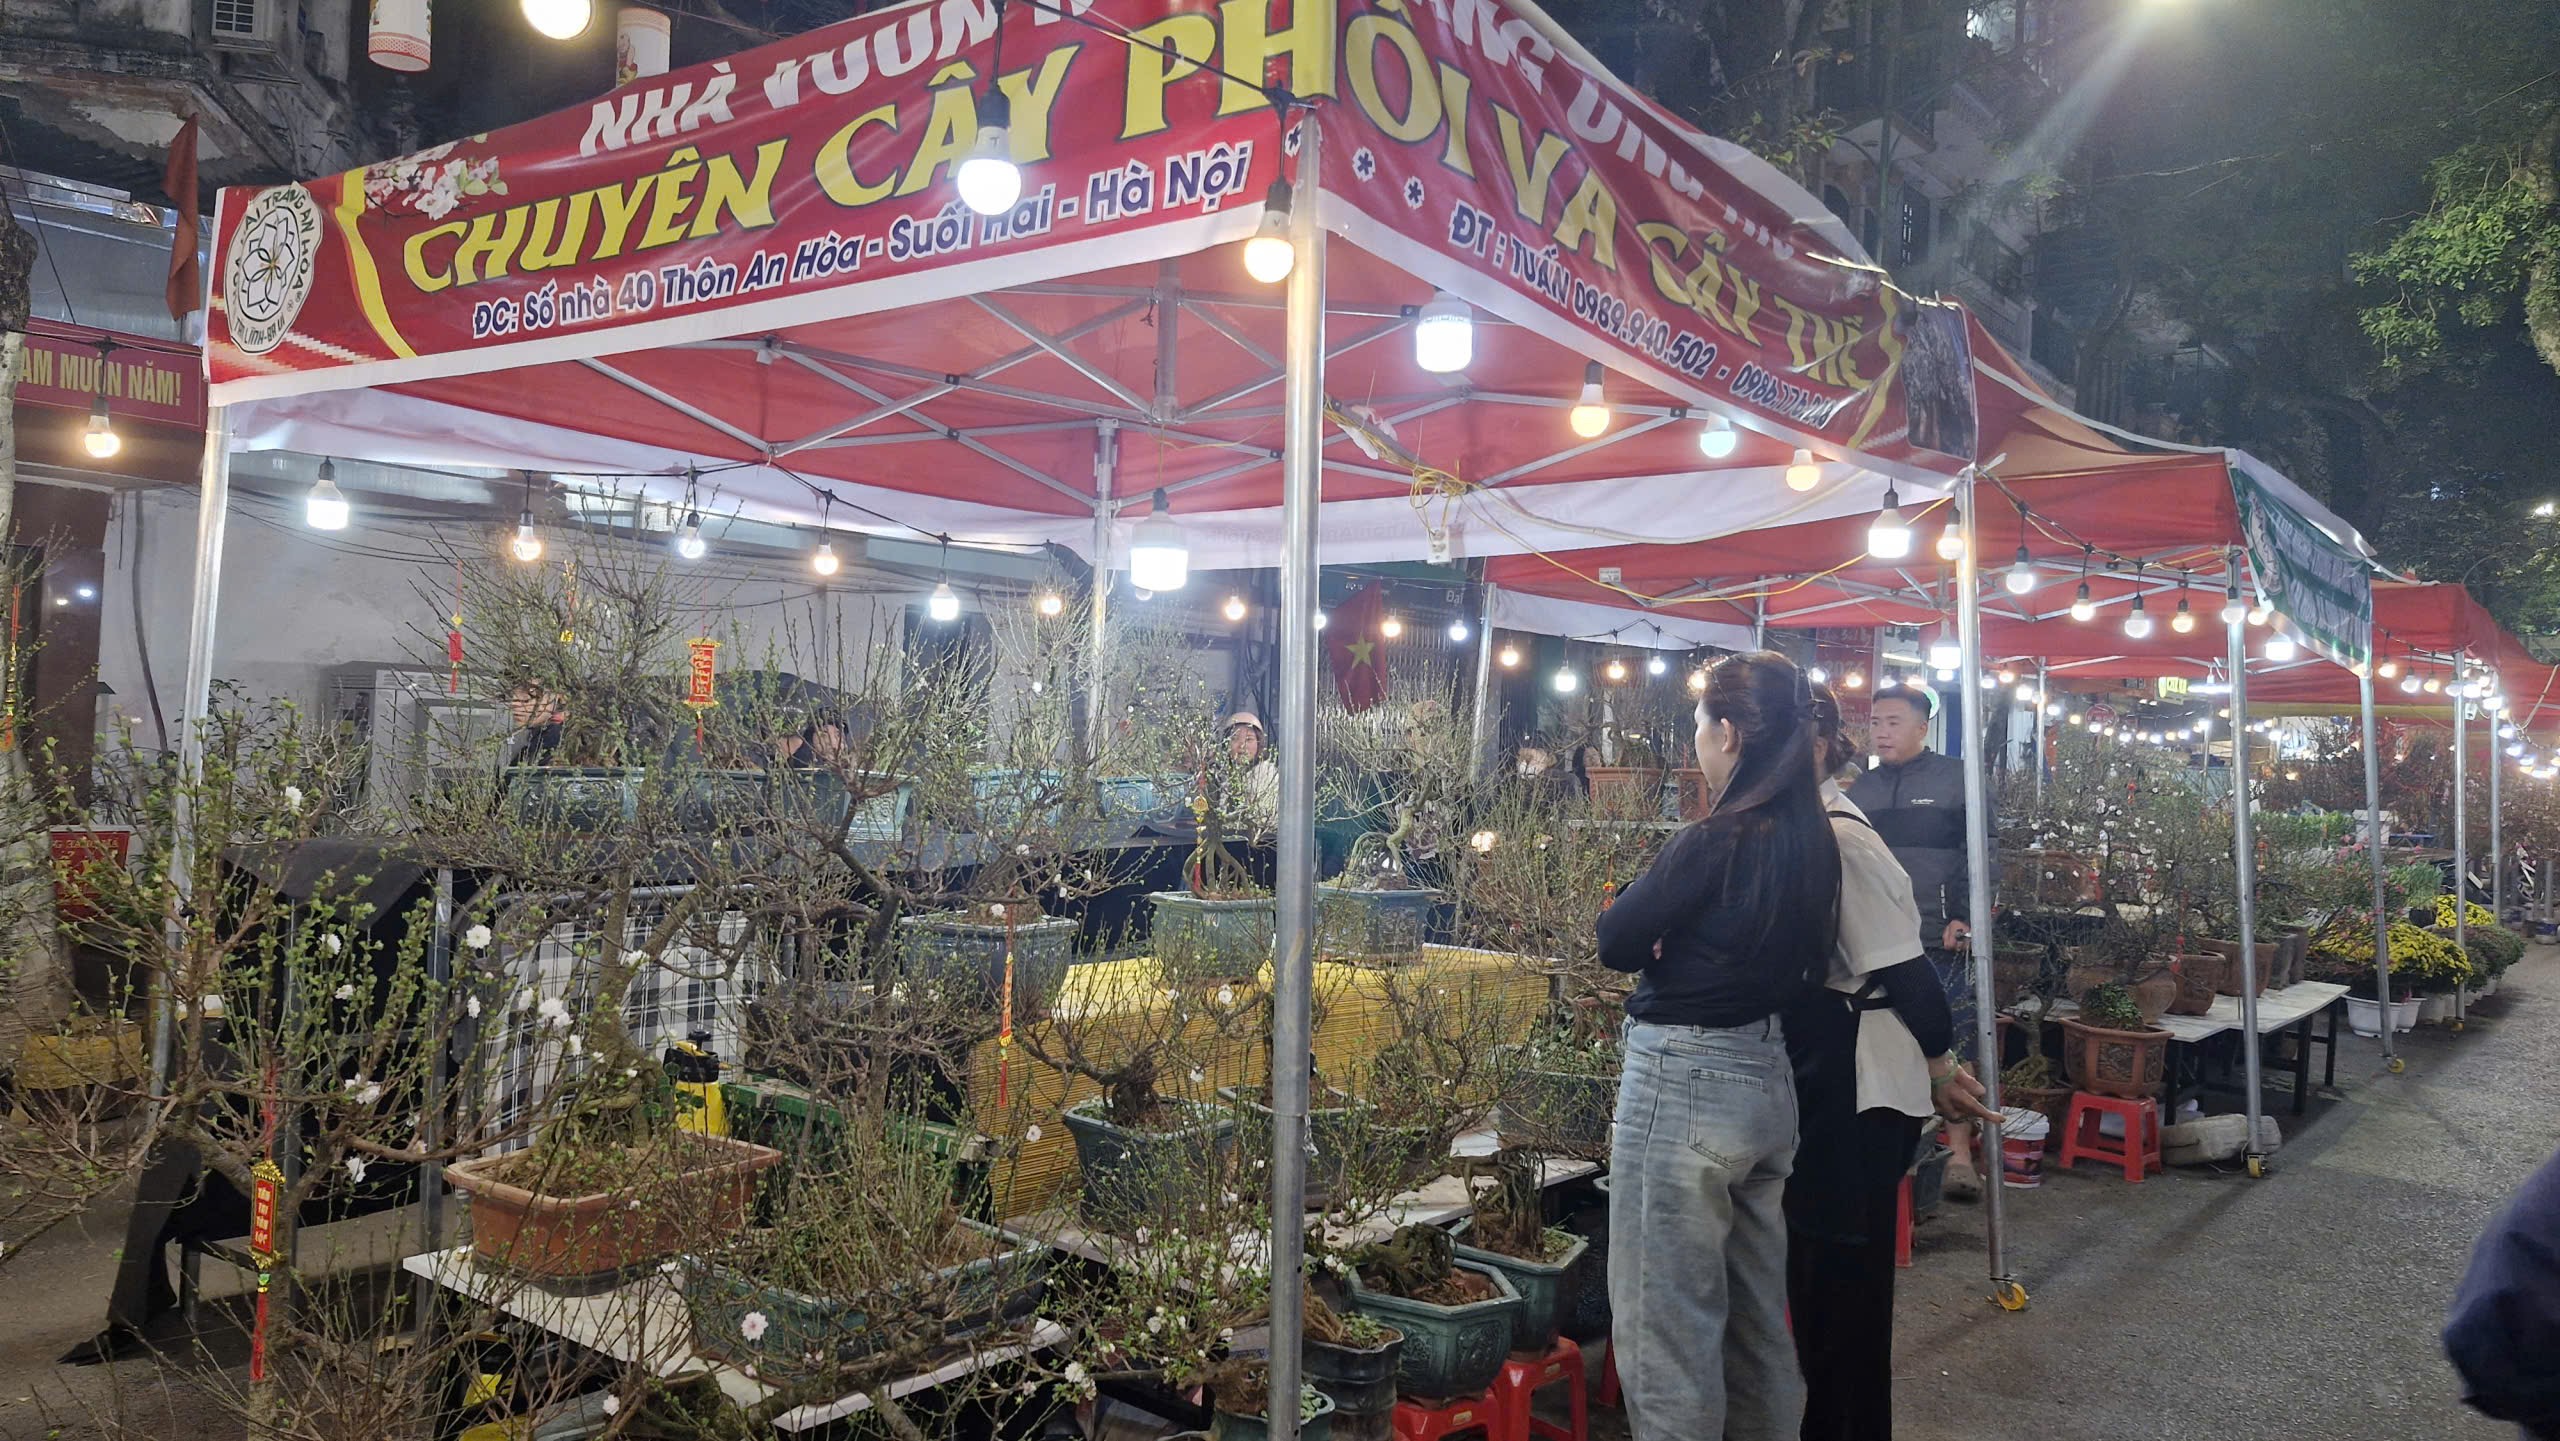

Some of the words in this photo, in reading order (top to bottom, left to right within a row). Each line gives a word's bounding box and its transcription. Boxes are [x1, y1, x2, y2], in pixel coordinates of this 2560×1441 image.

[581, 62, 737, 157] NHÀ
[403, 138, 789, 293] CHUYÊN
[814, 44, 1082, 206] CÂY
[1636, 221, 1762, 347] CÂY
[474, 298, 519, 338] ĐC:
[524, 279, 557, 330] Số
[560, 275, 611, 324] nhà
[618, 270, 656, 311] 40
[662, 257, 738, 307] Thôn
[740, 251, 788, 292] An
[791, 232, 865, 282] Hòa
[1086, 159, 1155, 224] Hà
[1164, 140, 1253, 212] Nội
[18, 347, 52, 387] AM
[128, 360, 181, 406] NĂM!
[1508, 231, 1570, 305] TUẤN
[1573, 279, 1718, 377] 0989.940.502
